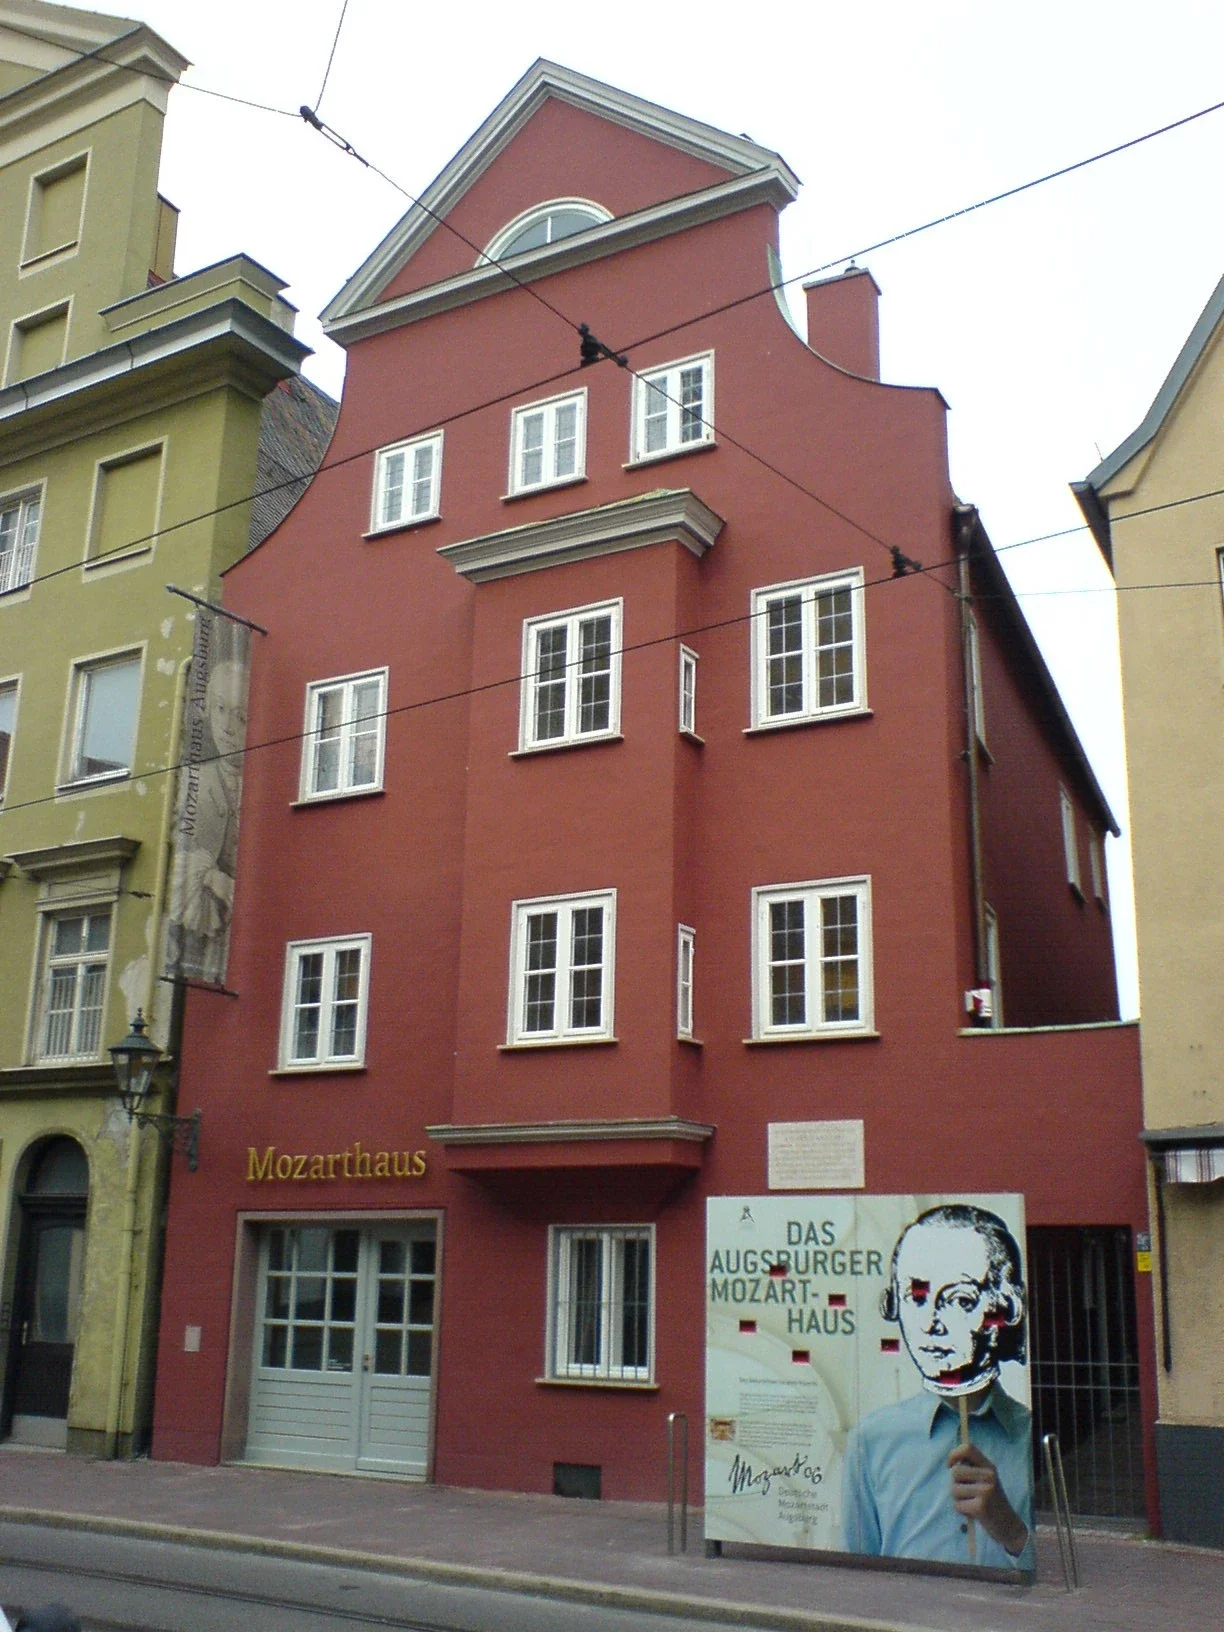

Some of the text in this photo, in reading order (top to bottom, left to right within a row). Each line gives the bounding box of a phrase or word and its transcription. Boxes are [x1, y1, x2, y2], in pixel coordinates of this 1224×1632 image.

[180, 616, 211, 837] Mozarthaus Augsburg
[247, 1142, 427, 1181] Mozarthaus
[787, 1220, 836, 1246] DAS
[710, 1249, 883, 1276] AUGSBURGER
[711, 1277, 819, 1304] MOZART-
[787, 1308, 856, 1335] HAUS
